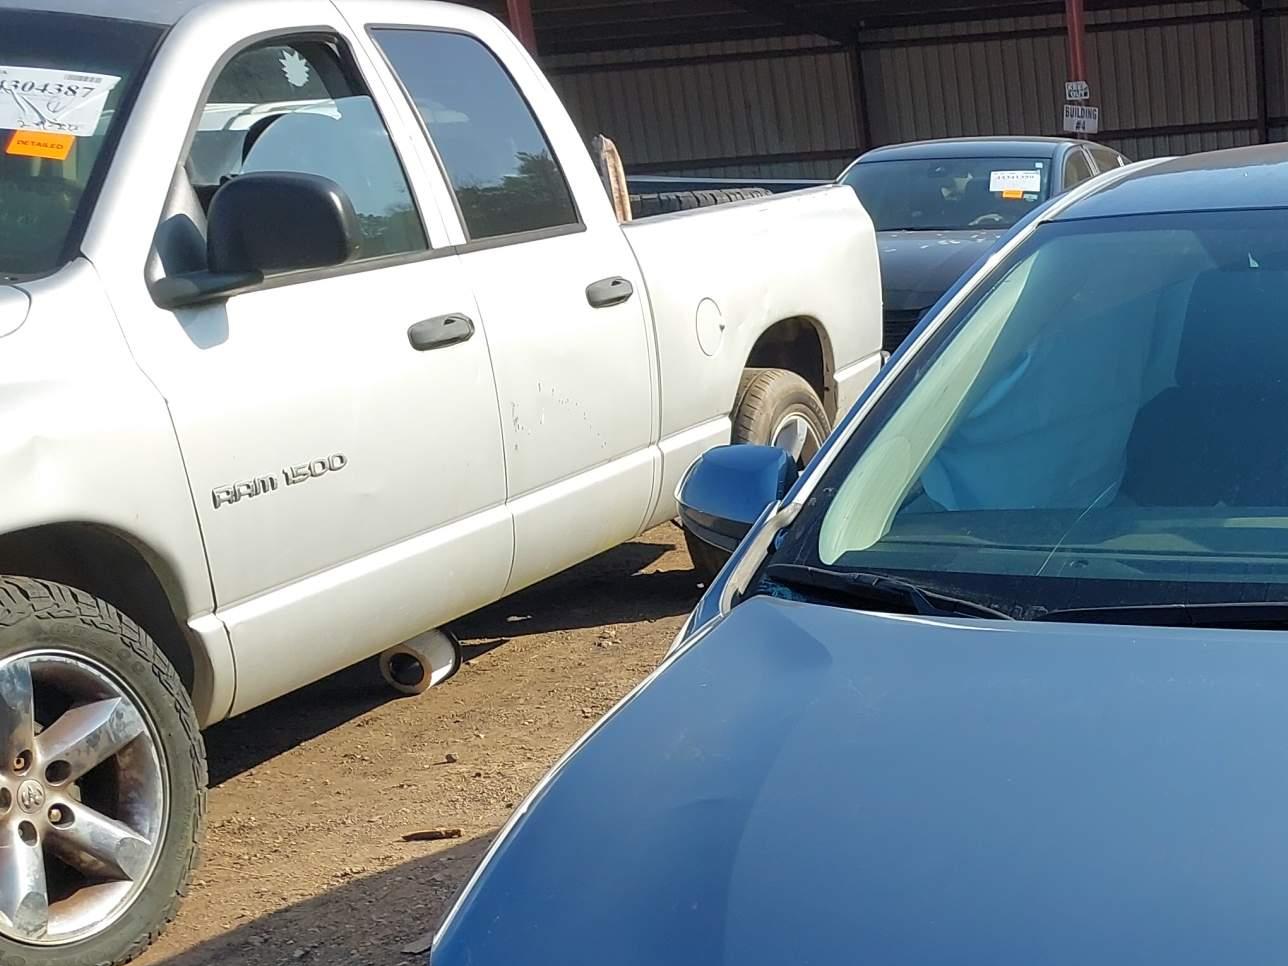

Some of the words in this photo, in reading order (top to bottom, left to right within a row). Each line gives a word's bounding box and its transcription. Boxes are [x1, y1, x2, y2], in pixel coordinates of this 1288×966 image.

[1065, 106, 1097, 120] BUILDING
[17, 140, 63, 149] DETAILED
[211, 477, 278, 509] RAM
[282, 453, 347, 486] 1500
